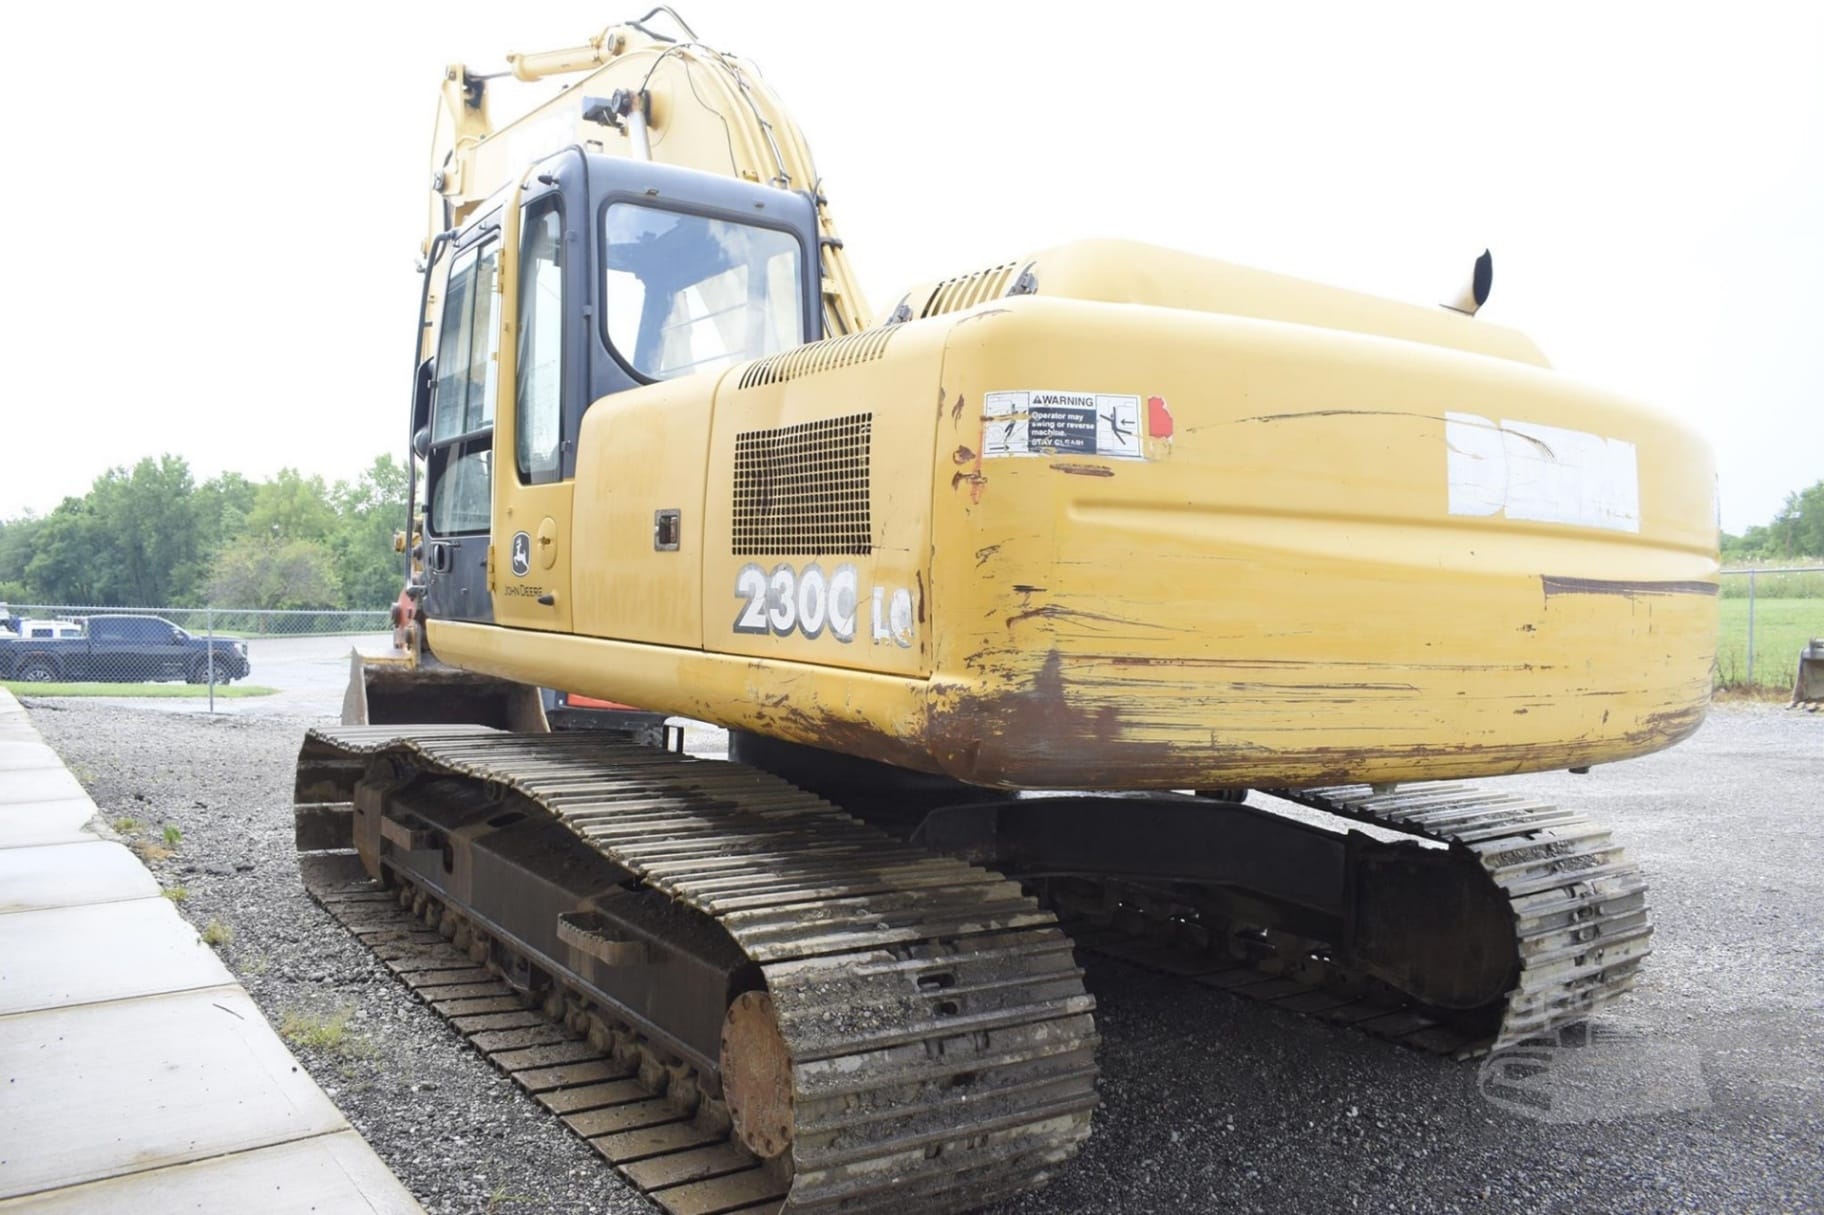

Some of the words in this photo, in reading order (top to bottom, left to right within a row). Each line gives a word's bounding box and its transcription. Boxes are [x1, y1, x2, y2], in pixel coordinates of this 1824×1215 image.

[1042, 395, 1094, 407] WARNING
[1031, 411, 1066, 421] Operator
[1067, 414, 1084, 422] may
[504, 585, 520, 597] JOHN
[520, 584, 543, 597] DEERE
[733, 562, 858, 643] 230C
